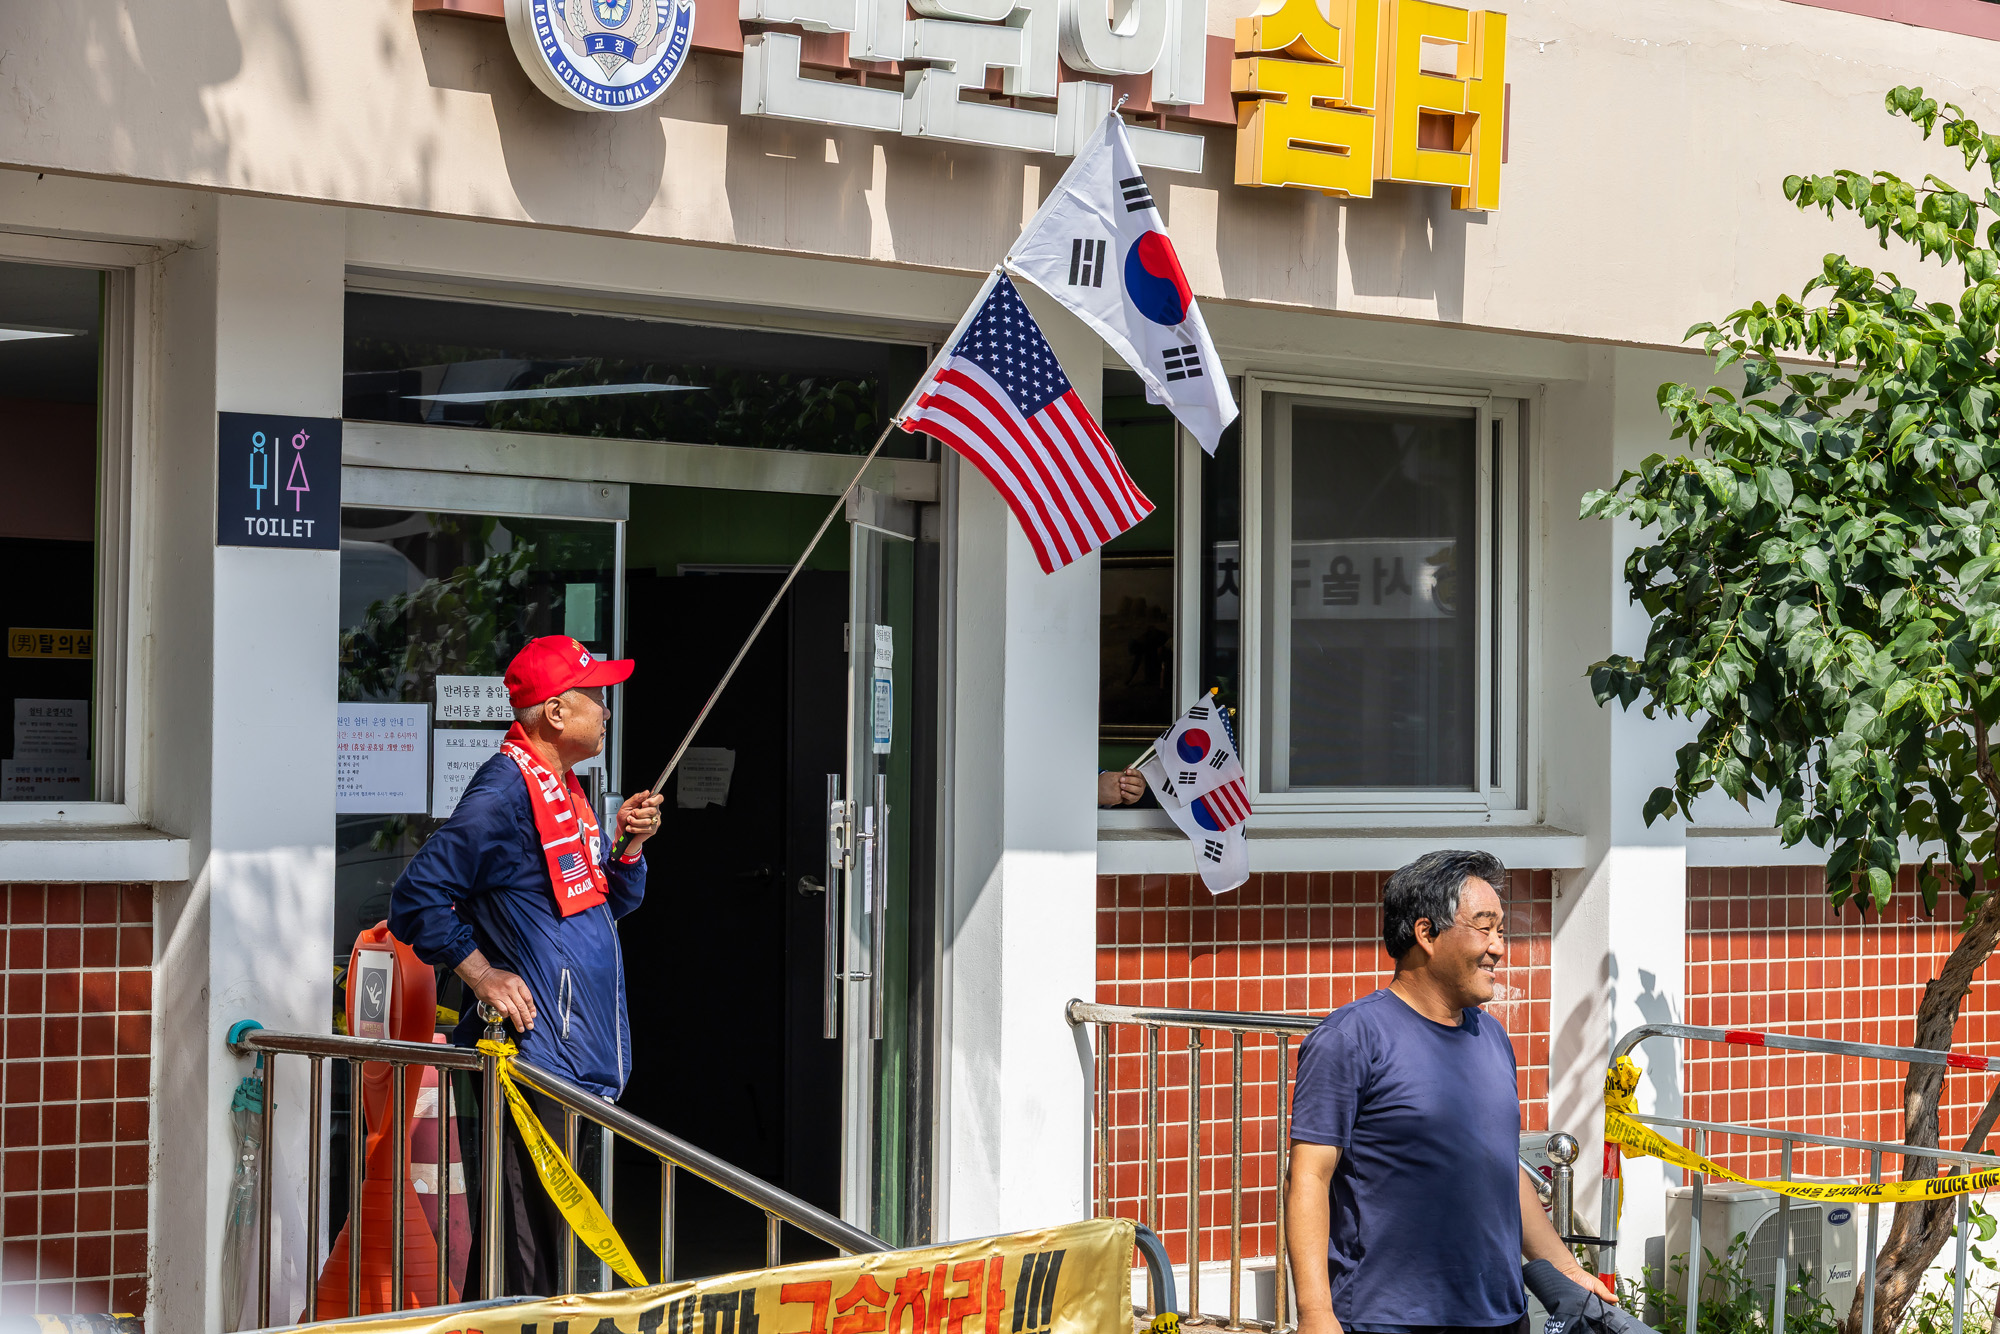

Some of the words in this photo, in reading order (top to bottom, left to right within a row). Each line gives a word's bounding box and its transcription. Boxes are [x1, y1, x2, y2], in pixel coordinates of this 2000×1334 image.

[534, 3, 558, 58] KOREA
[557, 60, 650, 104] CORRECTIONAL
[652, 25, 688, 85] SERVICE
[1231, 0, 1508, 212] 쉼터
[244, 517, 315, 538] TOILET
[443, 685, 481, 698] 반려동물
[443, 705, 481, 718] 반려동물
[354, 717, 368, 727] 쉼터
[372, 717, 386, 727] 운영
[390, 717, 404, 727] 안내
[351, 732, 363, 740] 오전
[365, 732, 375, 740] 8시
[384, 732, 396, 740] 오후
[397, 731, 418, 740] 6시까지
[387, 744, 398, 752] 개방
[1925, 1177, 1970, 1195] POLICE
[1972, 1172, 2000, 1190] LINE
[1824, 1183, 1886, 1199] 넘지마시오
[1829, 1211, 1850, 1222] Carrier
